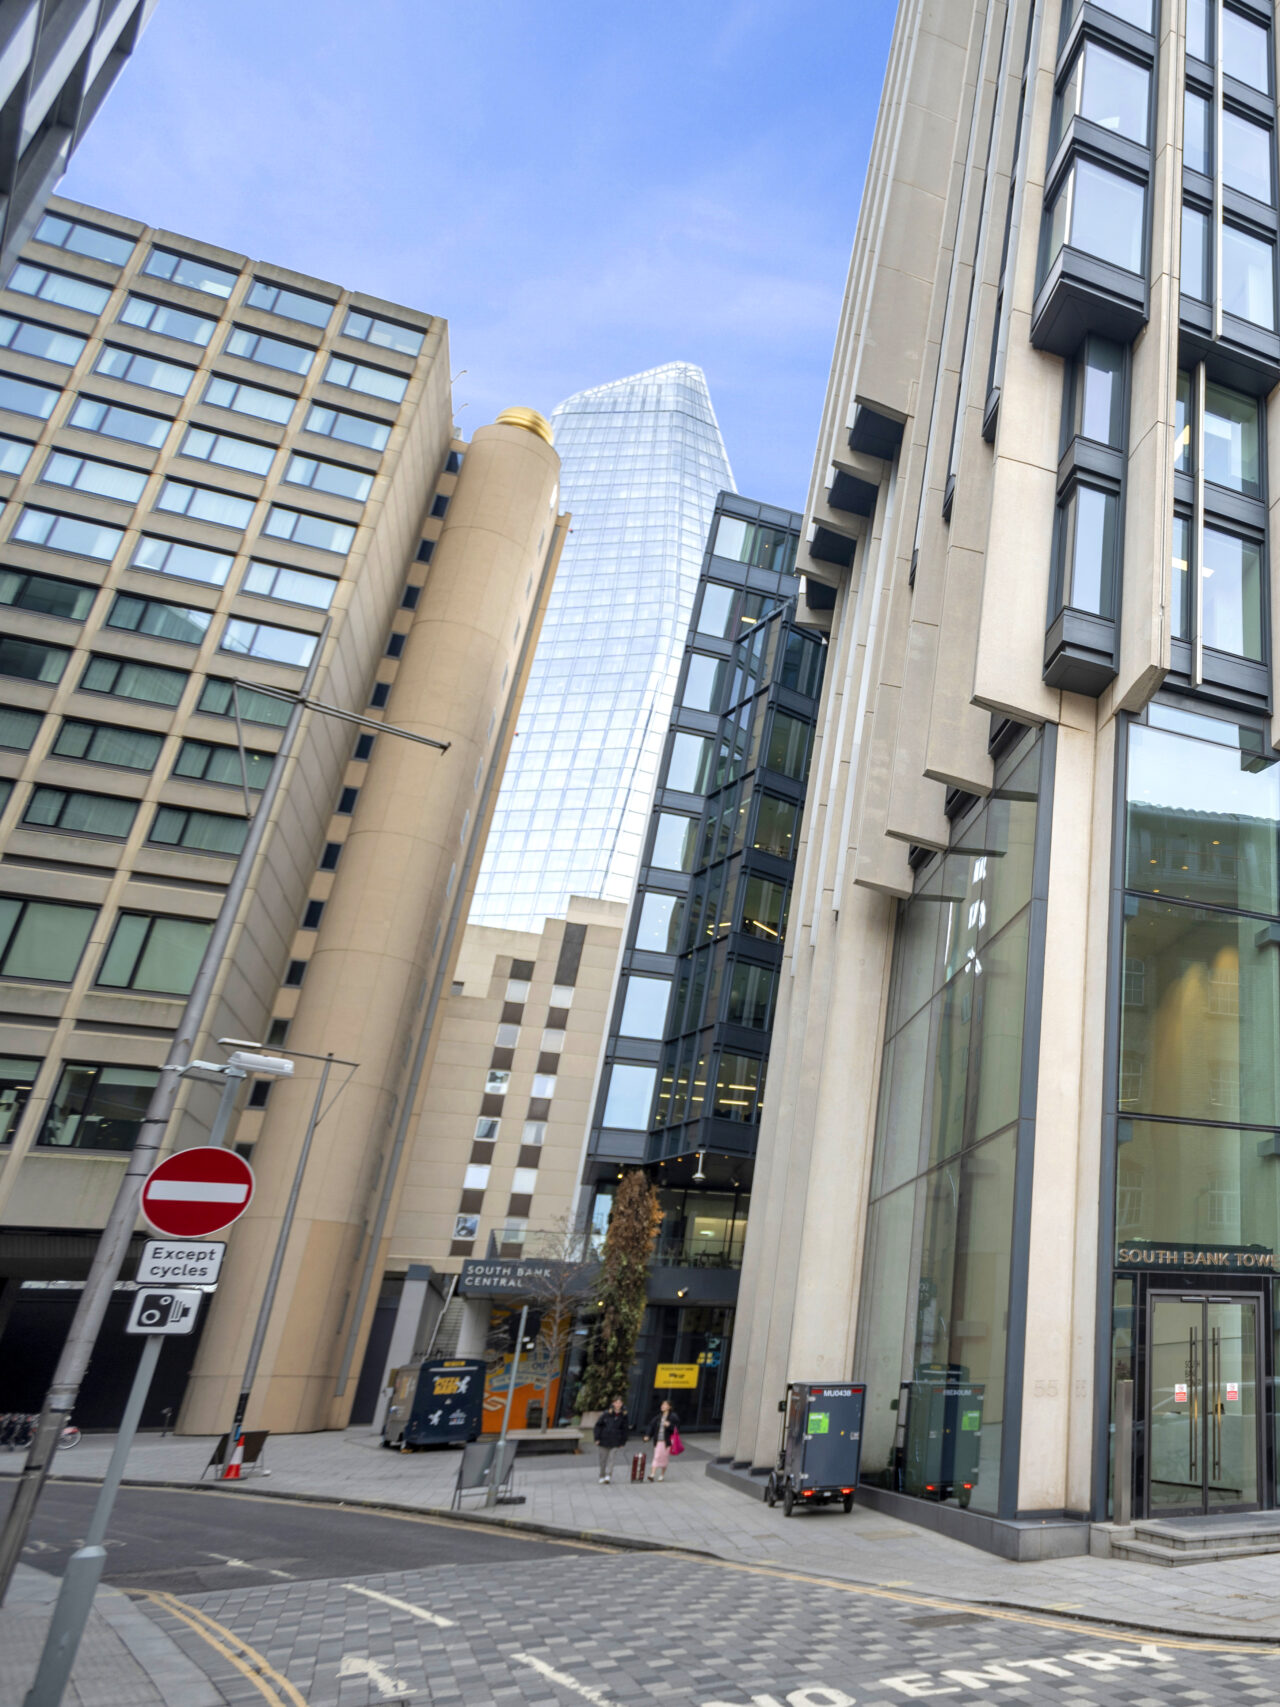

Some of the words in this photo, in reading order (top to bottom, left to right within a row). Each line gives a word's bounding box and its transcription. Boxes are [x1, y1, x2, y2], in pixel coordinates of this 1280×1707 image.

[151, 1247, 216, 1262] Except
[1118, 1249, 1178, 1265] SOUTH
[1183, 1251, 1230, 1266] BANK
[150, 1264, 208, 1278] cycles
[467, 1265, 511, 1276] SOUTH
[516, 1267, 551, 1277] BANK
[464, 1276, 523, 1287] CENTRAL
[878, 1645, 1175, 1697] ENTRY
